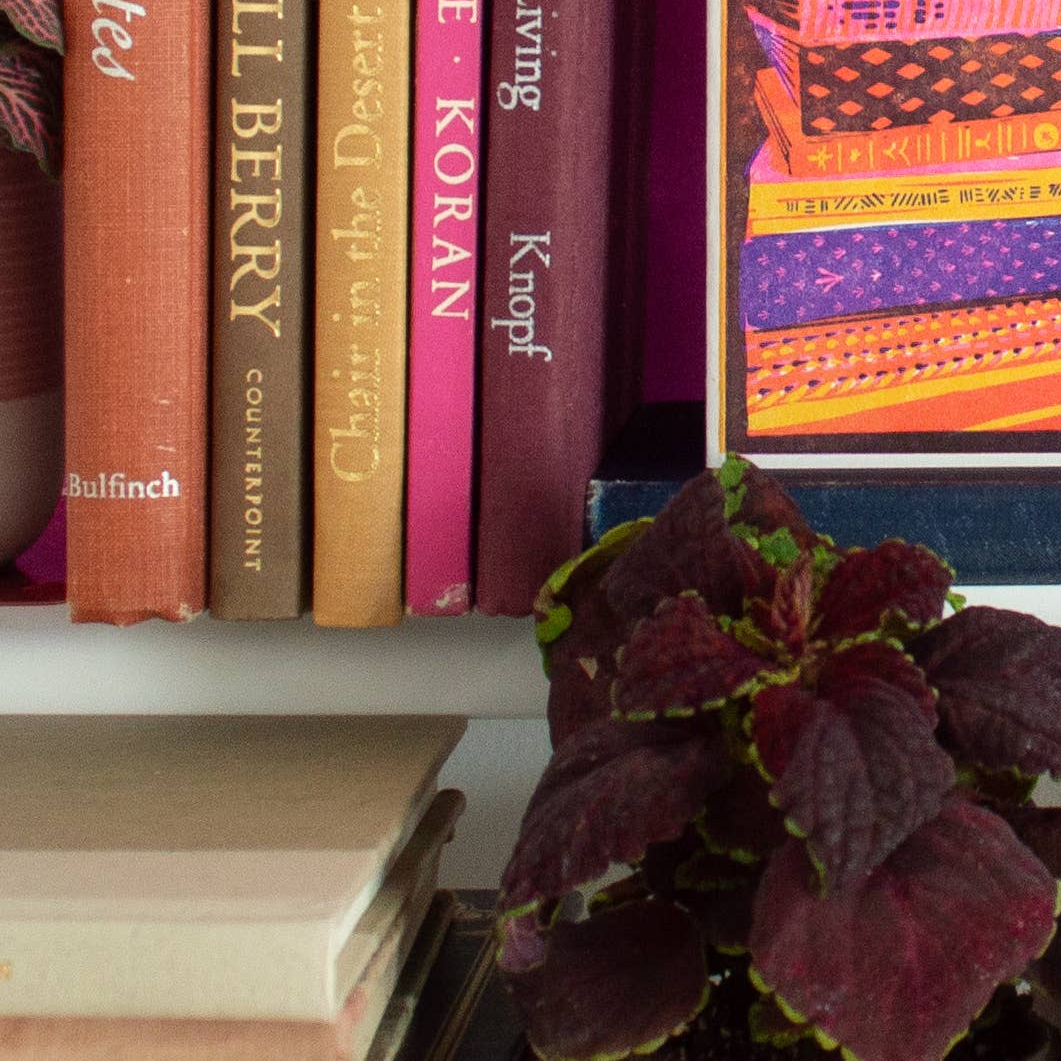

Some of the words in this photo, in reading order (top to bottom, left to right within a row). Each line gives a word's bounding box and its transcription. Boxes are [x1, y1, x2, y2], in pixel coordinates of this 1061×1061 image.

[333, 5, 384, 170] Desert
[229, 99, 285, 338] BERRY
[331, 185, 383, 263] the
[430, 96, 476, 322] KORAN
[332, 279, 382, 330] in
[491, 231, 552, 363] Knopf
[242, 369, 264, 572] COUNTERPOINT
[330, 343, 382, 483] Chair
[68, 470, 180, 499] Bulfinch
